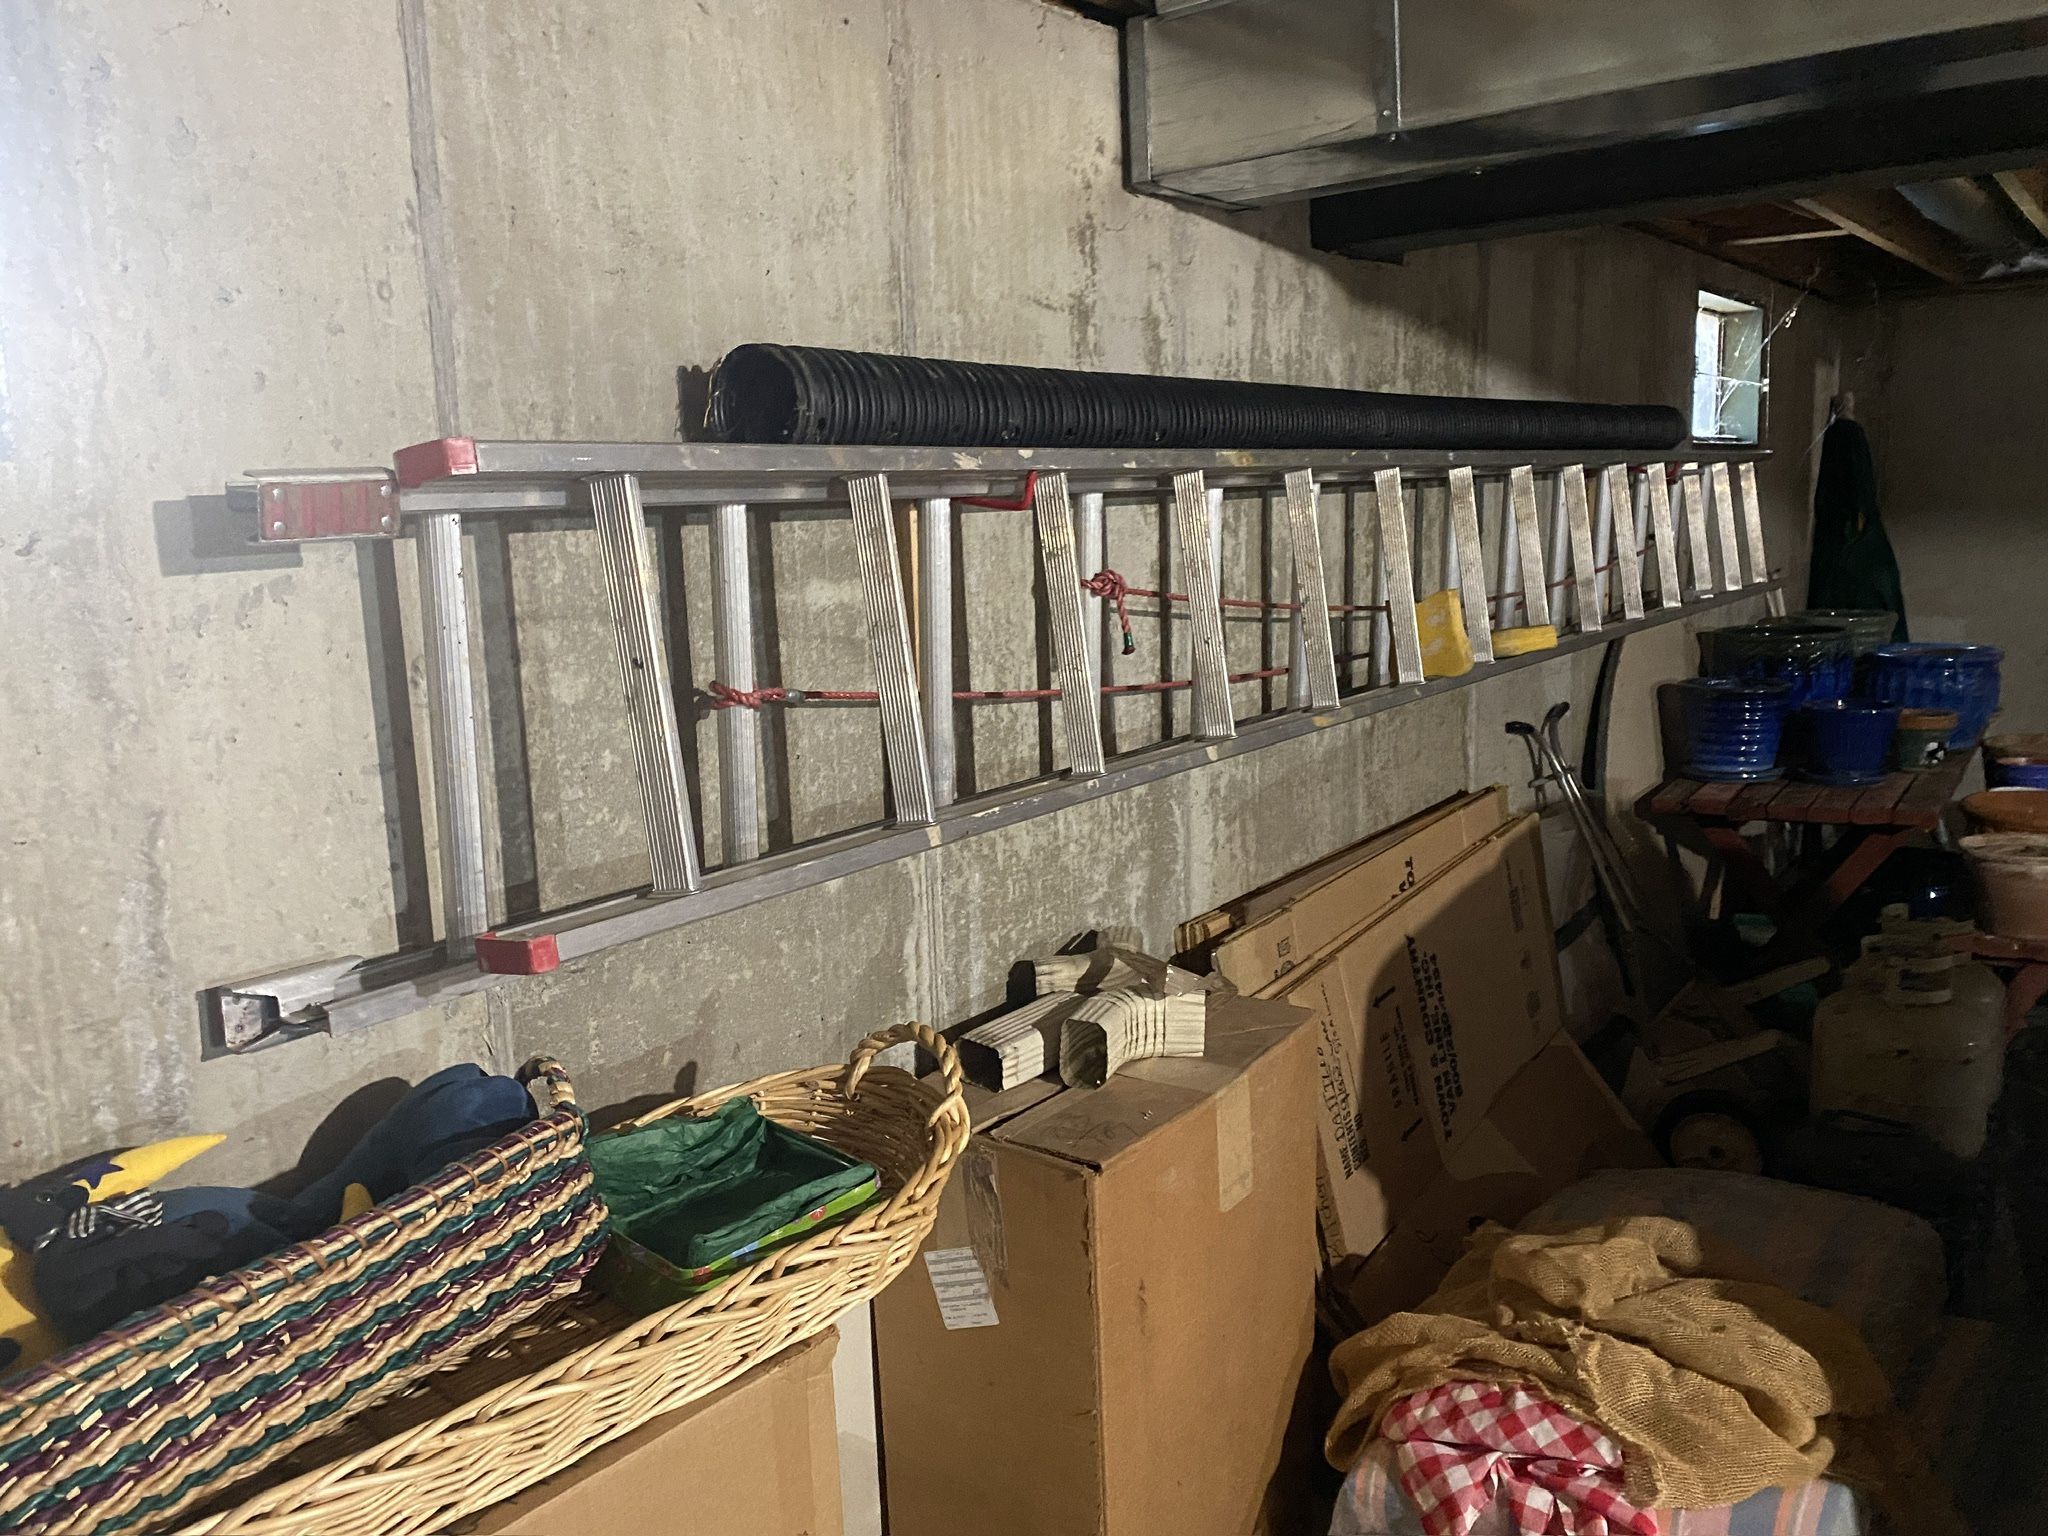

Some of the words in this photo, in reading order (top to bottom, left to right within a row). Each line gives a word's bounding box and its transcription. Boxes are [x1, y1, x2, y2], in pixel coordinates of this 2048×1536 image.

[1404, 934, 1434, 1046] COUNTRY
[1380, 1031, 1402, 1109] FRAGILE
[1442, 1071, 1456, 1115] VAN
[1434, 1074, 1453, 1141] TOWN
[1339, 1144, 1354, 1180] NAME
[1343, 1110, 1362, 1171] CONTENTS
